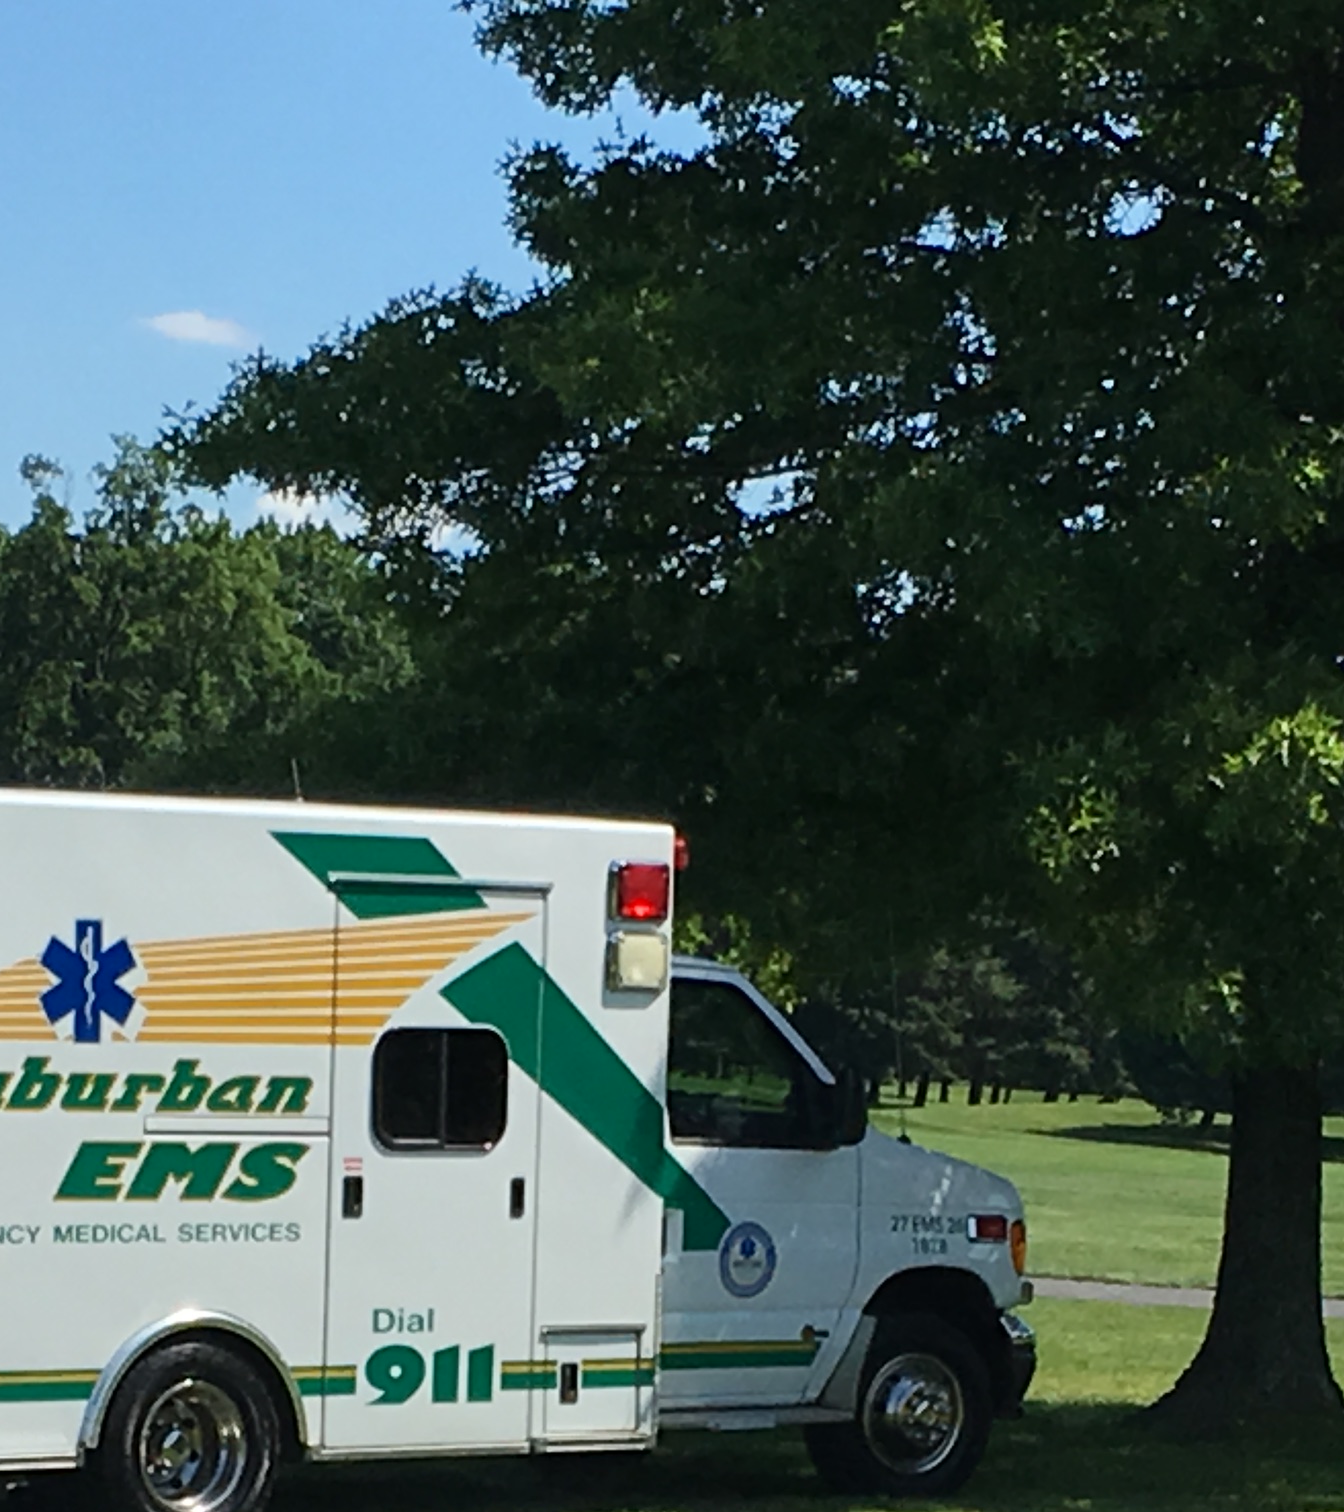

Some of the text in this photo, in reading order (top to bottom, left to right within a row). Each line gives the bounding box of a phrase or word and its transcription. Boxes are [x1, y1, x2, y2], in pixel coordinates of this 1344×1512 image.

[53, 1140, 311, 1203] EMS
[53, 1223, 167, 1245] MEDICAL
[177, 1222, 301, 1244] SERVICES
[371, 1307, 435, 1335] Dial
[364, 1343, 496, 1405] 911
